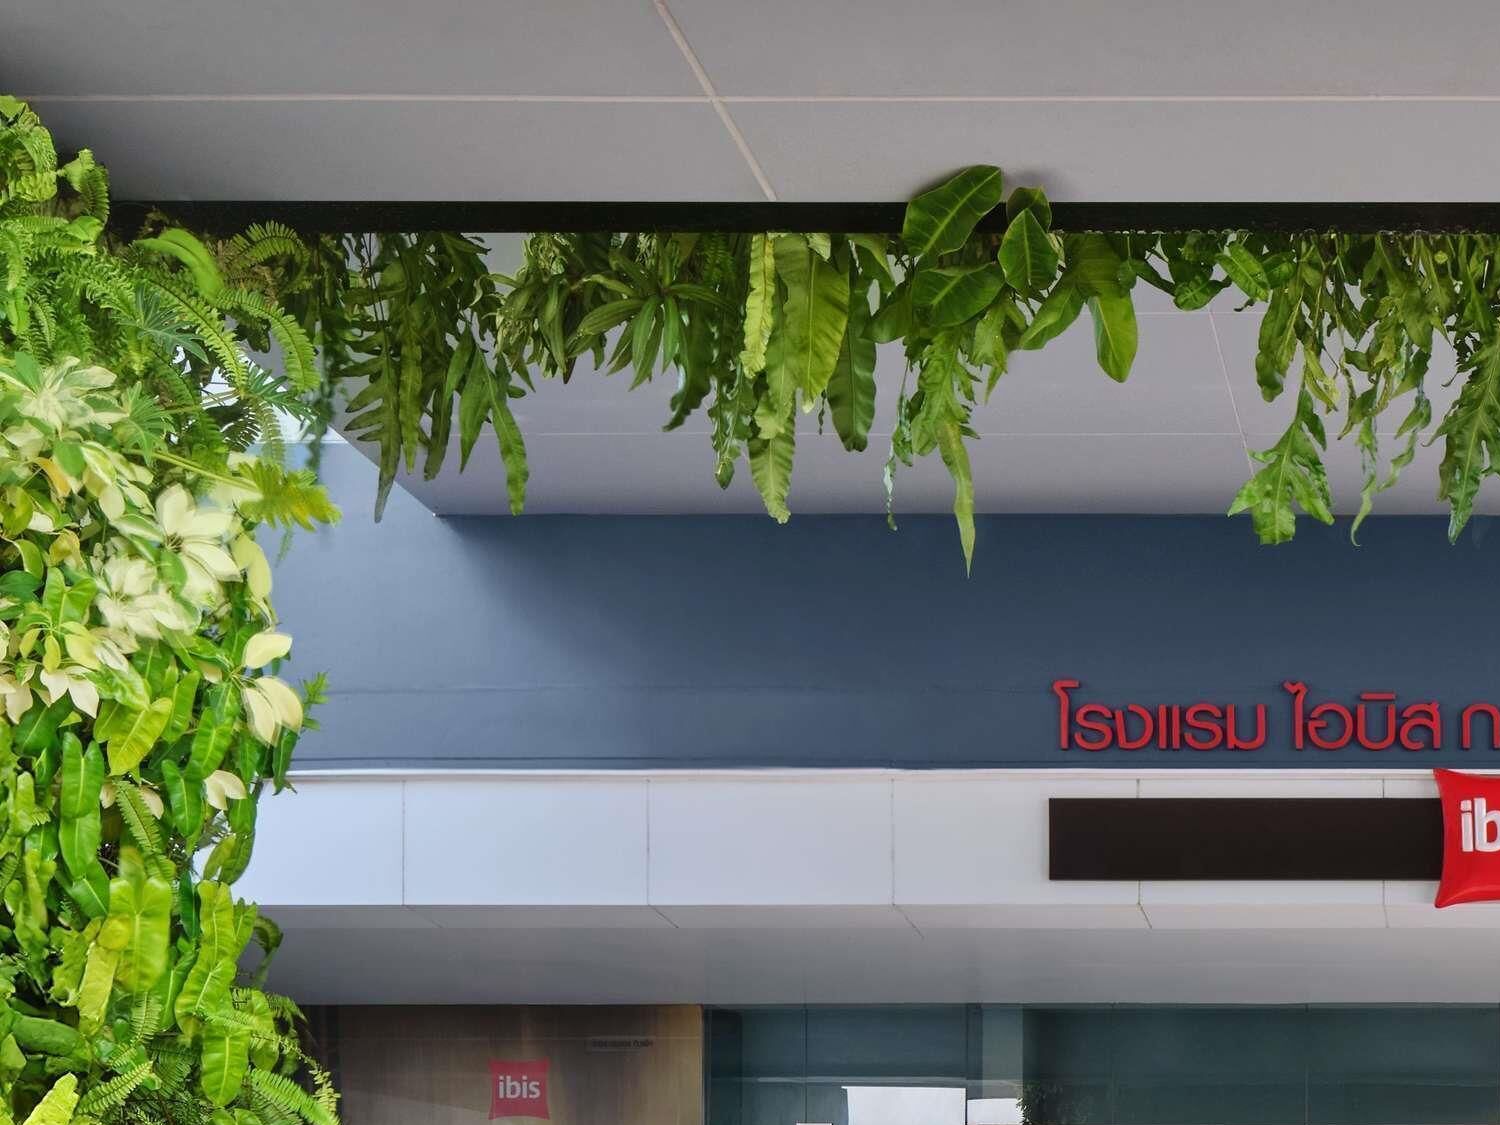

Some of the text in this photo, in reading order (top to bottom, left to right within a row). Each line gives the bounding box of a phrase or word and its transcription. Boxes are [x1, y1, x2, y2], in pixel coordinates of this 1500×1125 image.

[1053, 679, 1267, 751] โรงแรม
[1283, 681, 1441, 751] ไอบิส
[498, 1075, 541, 1099] ibis
